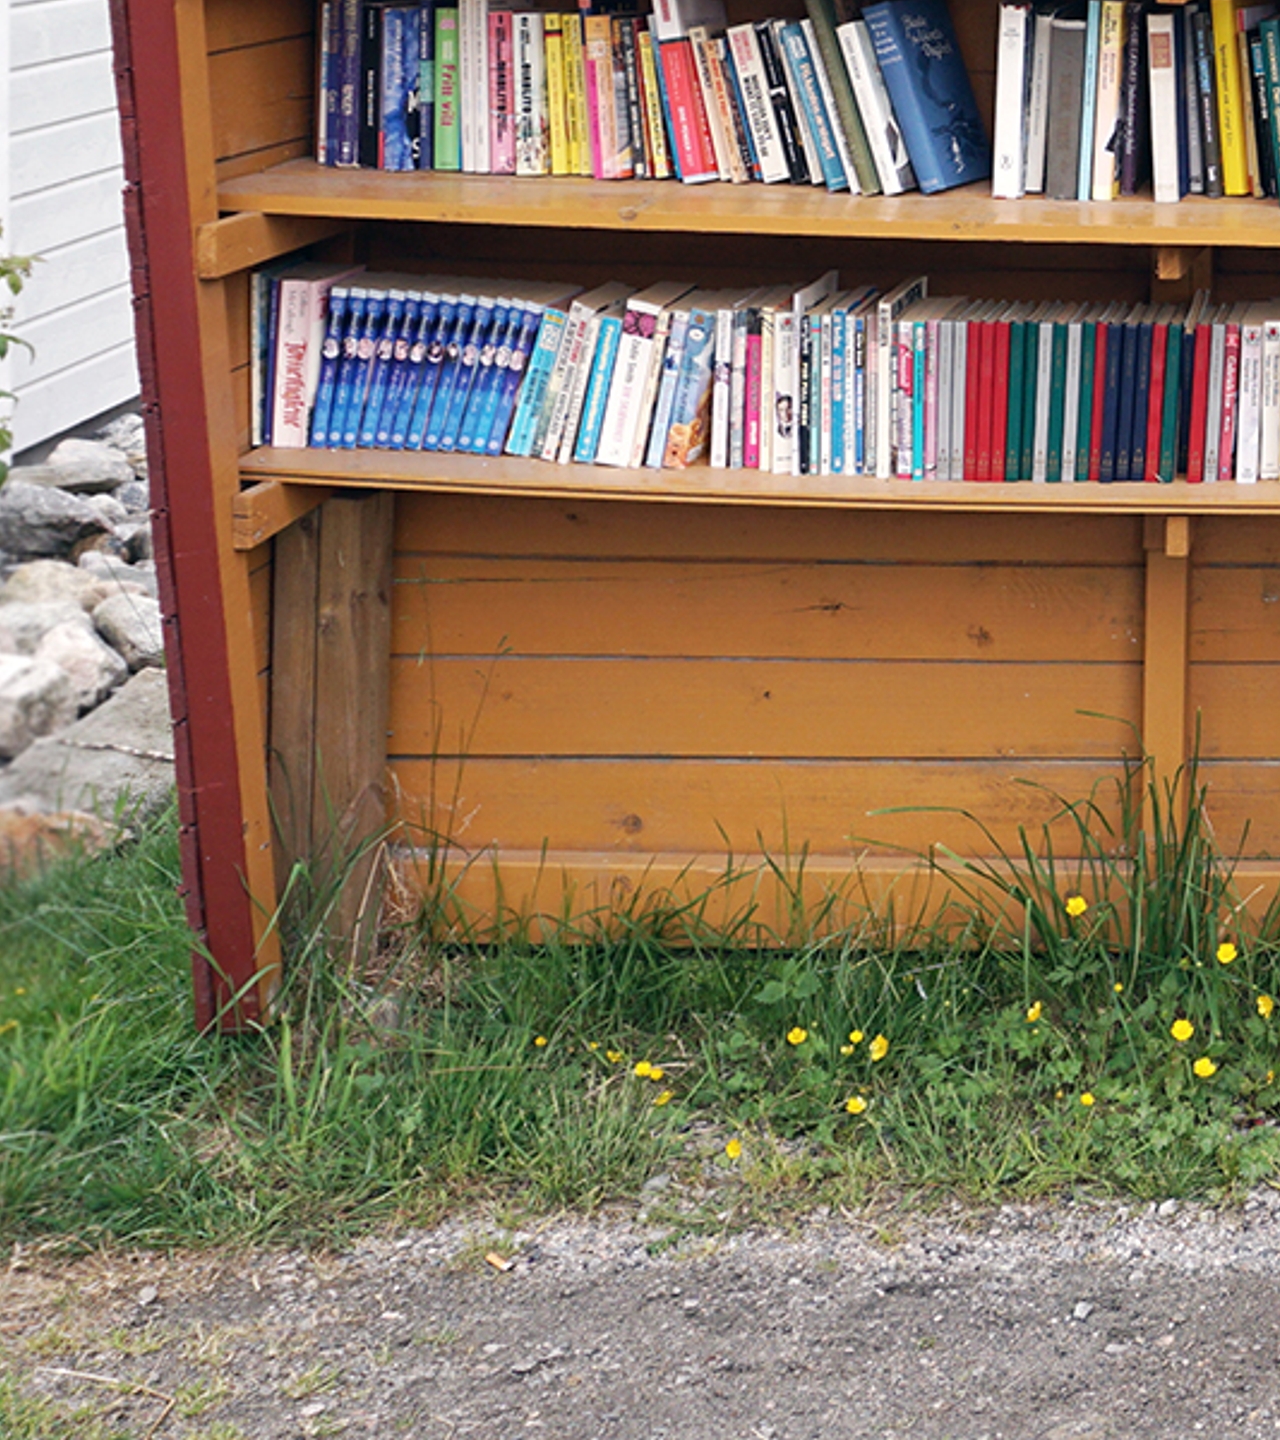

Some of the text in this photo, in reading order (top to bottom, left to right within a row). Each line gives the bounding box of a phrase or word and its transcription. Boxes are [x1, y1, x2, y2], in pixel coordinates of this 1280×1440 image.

[440, 64, 455, 96] Fritt
[627, 338, 642, 361] Zadie
[626, 361, 639, 385] Smith
